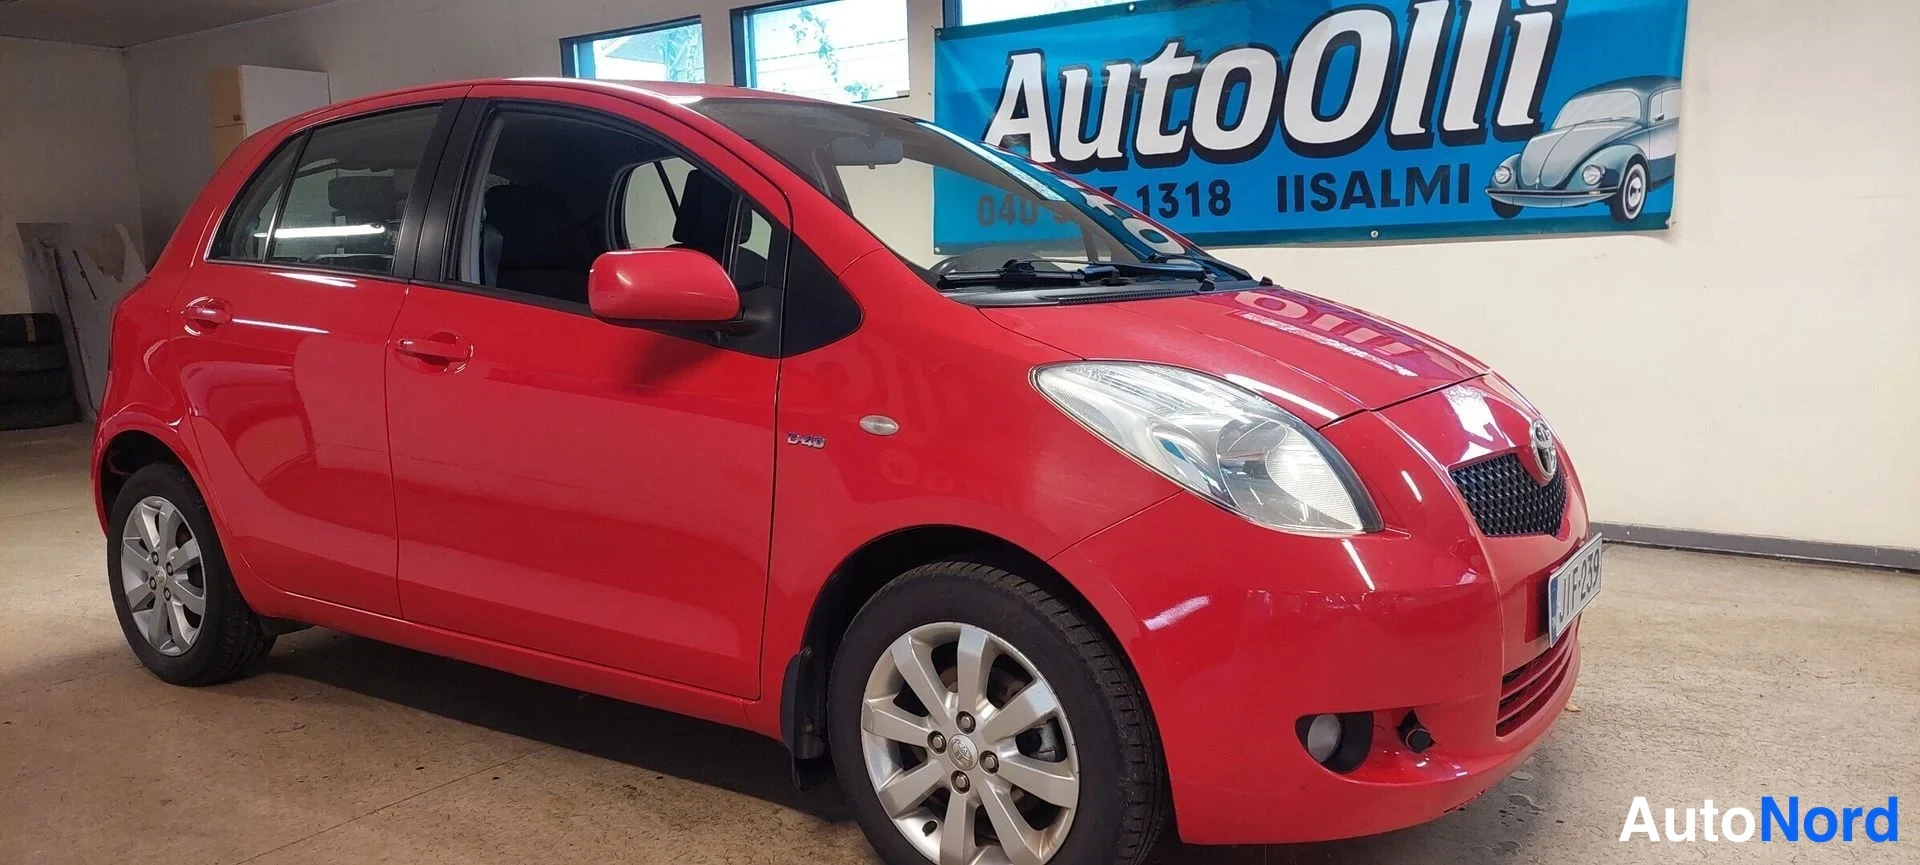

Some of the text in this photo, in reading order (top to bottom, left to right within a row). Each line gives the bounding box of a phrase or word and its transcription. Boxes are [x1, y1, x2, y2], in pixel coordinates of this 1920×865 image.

[983, 0, 1561, 169] AutoOlli
[977, 192, 1039, 227] 040
[1136, 178, 1231, 219] 1318
[1277, 163, 1470, 213] IISALMI
[1559, 548, 1600, 623] JIF-239
